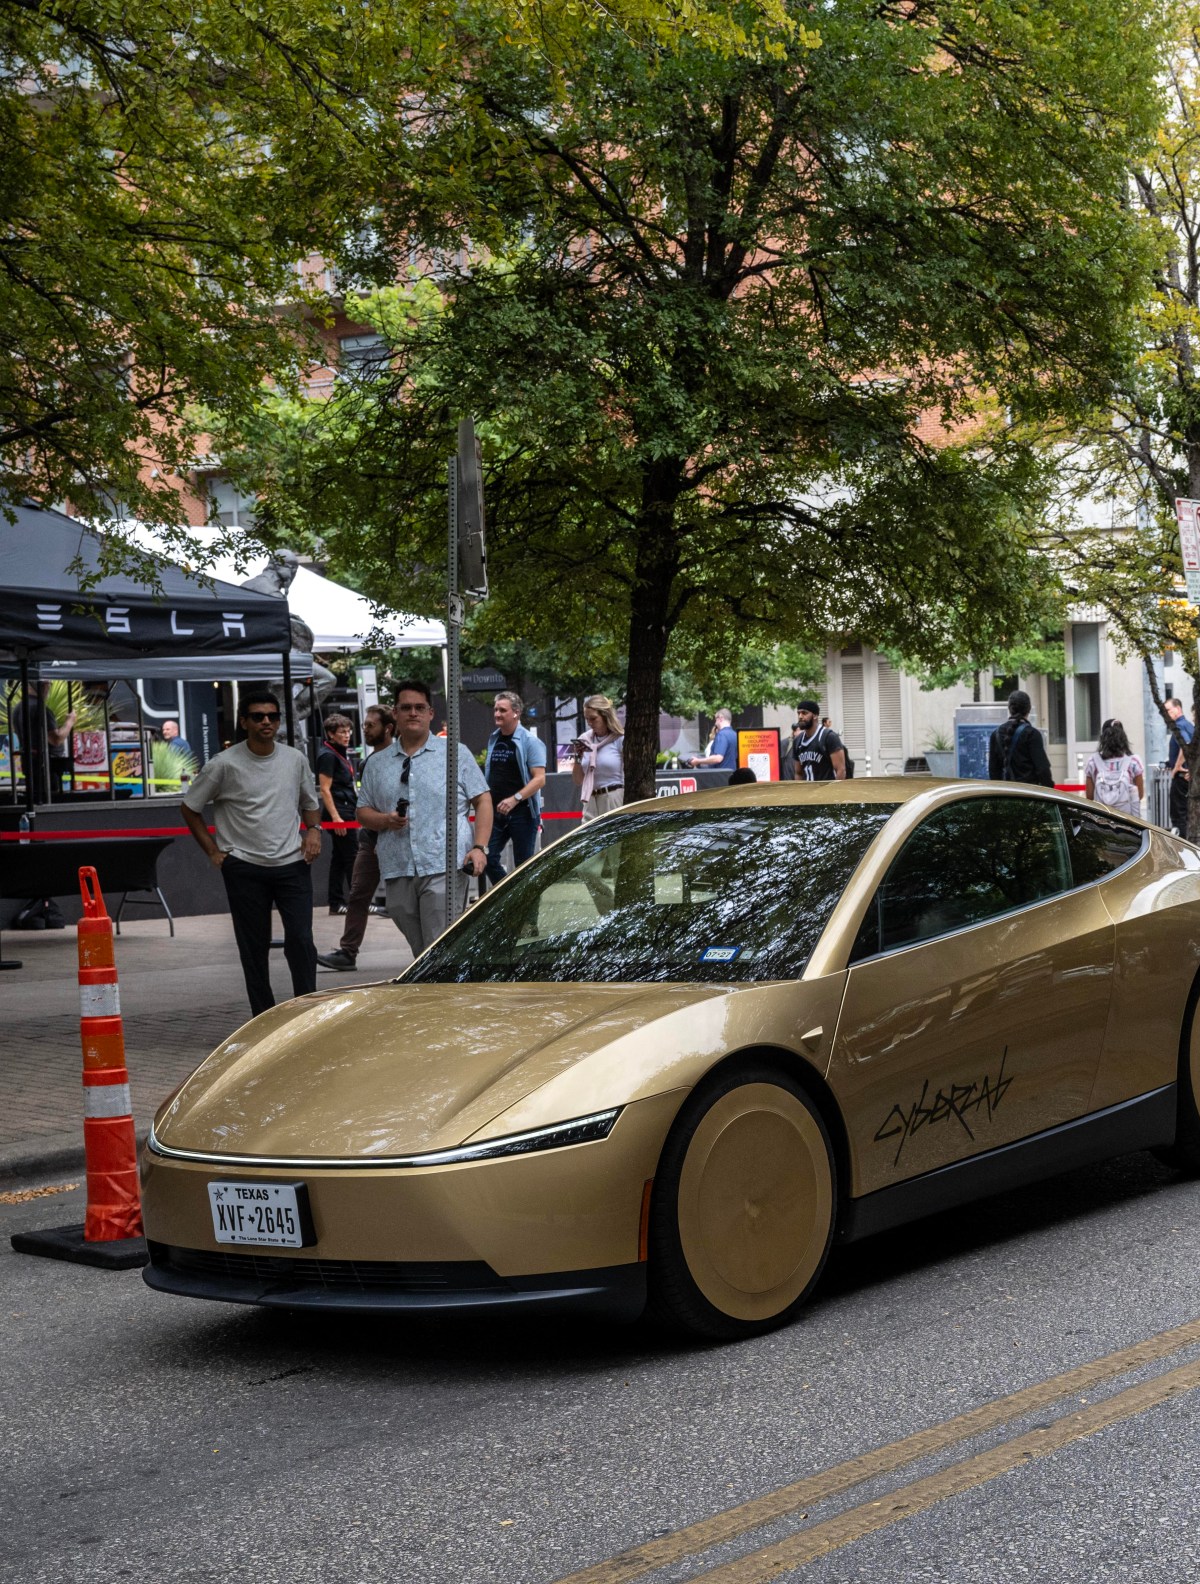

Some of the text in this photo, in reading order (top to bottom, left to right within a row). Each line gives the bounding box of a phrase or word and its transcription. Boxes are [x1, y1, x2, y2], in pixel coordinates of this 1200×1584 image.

[235, 1188, 269, 1201] TEXAS
[217, 1204, 295, 1235] XVF 2645
